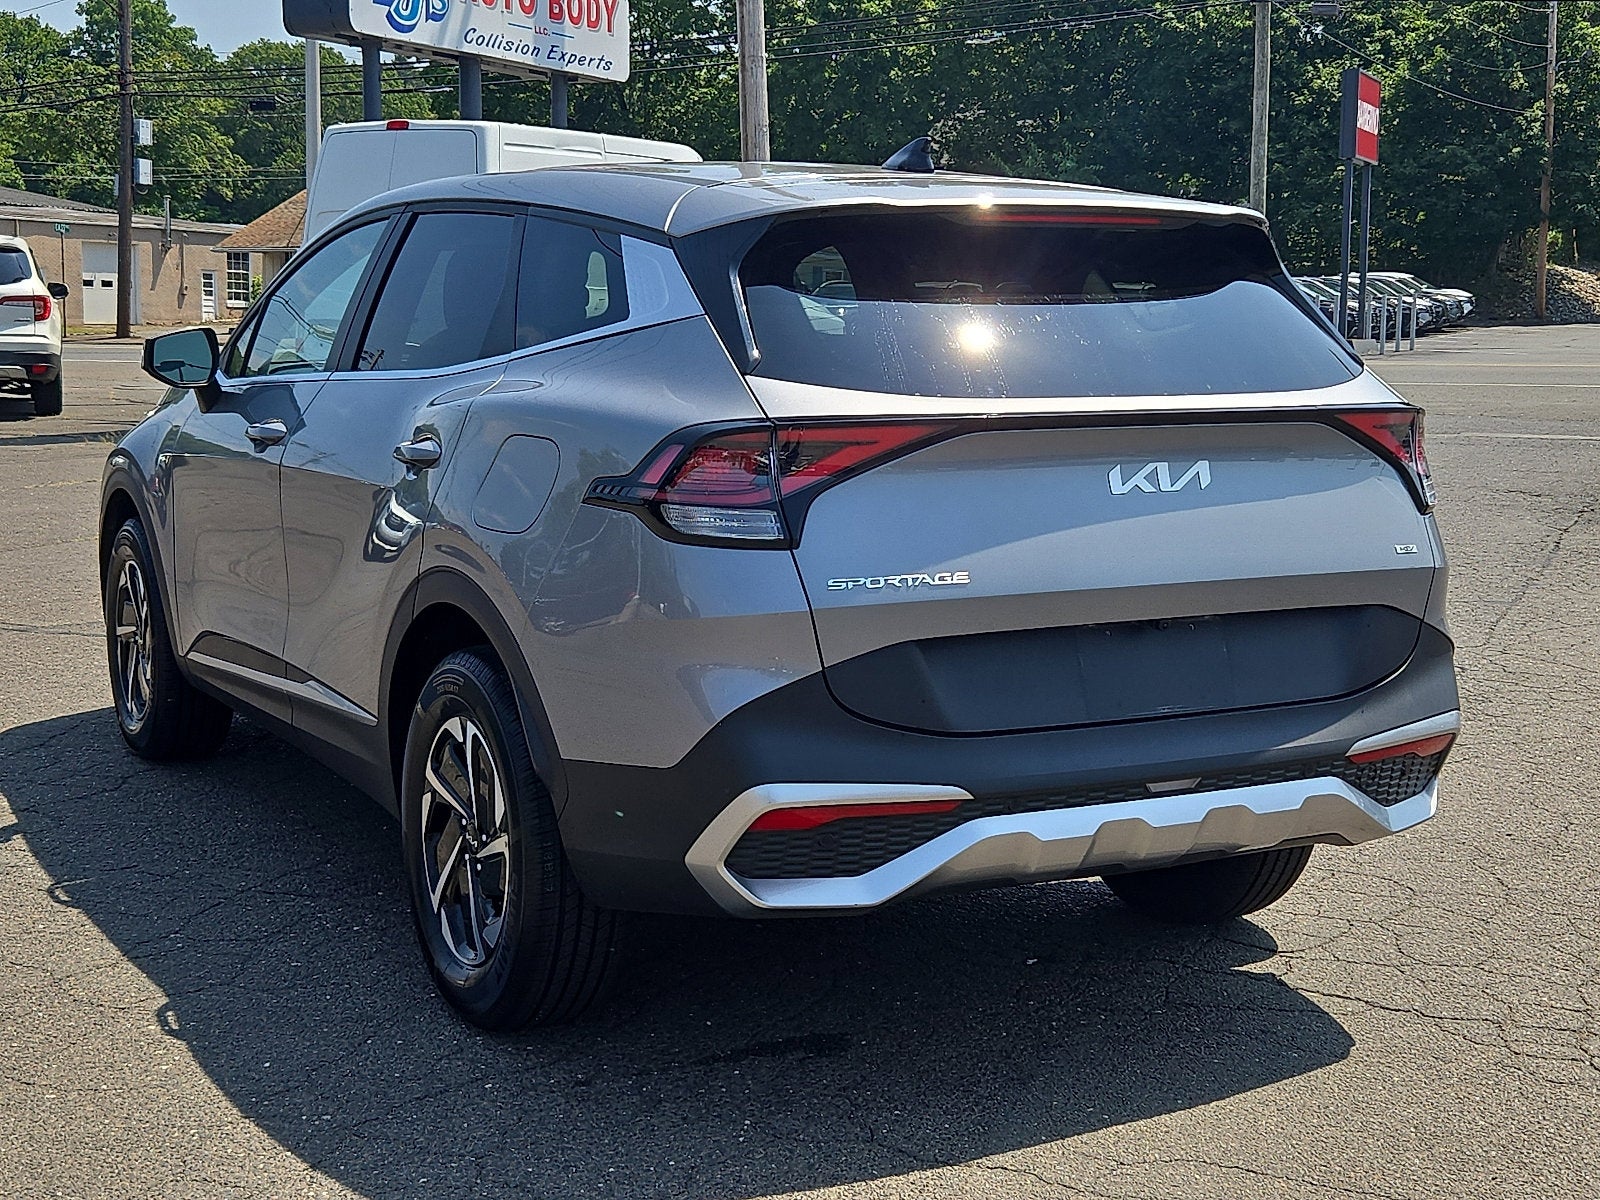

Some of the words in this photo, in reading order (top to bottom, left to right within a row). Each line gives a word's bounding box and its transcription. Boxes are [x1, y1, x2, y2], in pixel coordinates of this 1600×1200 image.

[534, 25, 551, 36] LLC.
[464, 27, 540, 57] Collision
[547, 45, 613, 71] Experts
[1107, 459, 1211, 495] KIA
[827, 571, 970, 590] SPORTAGE
